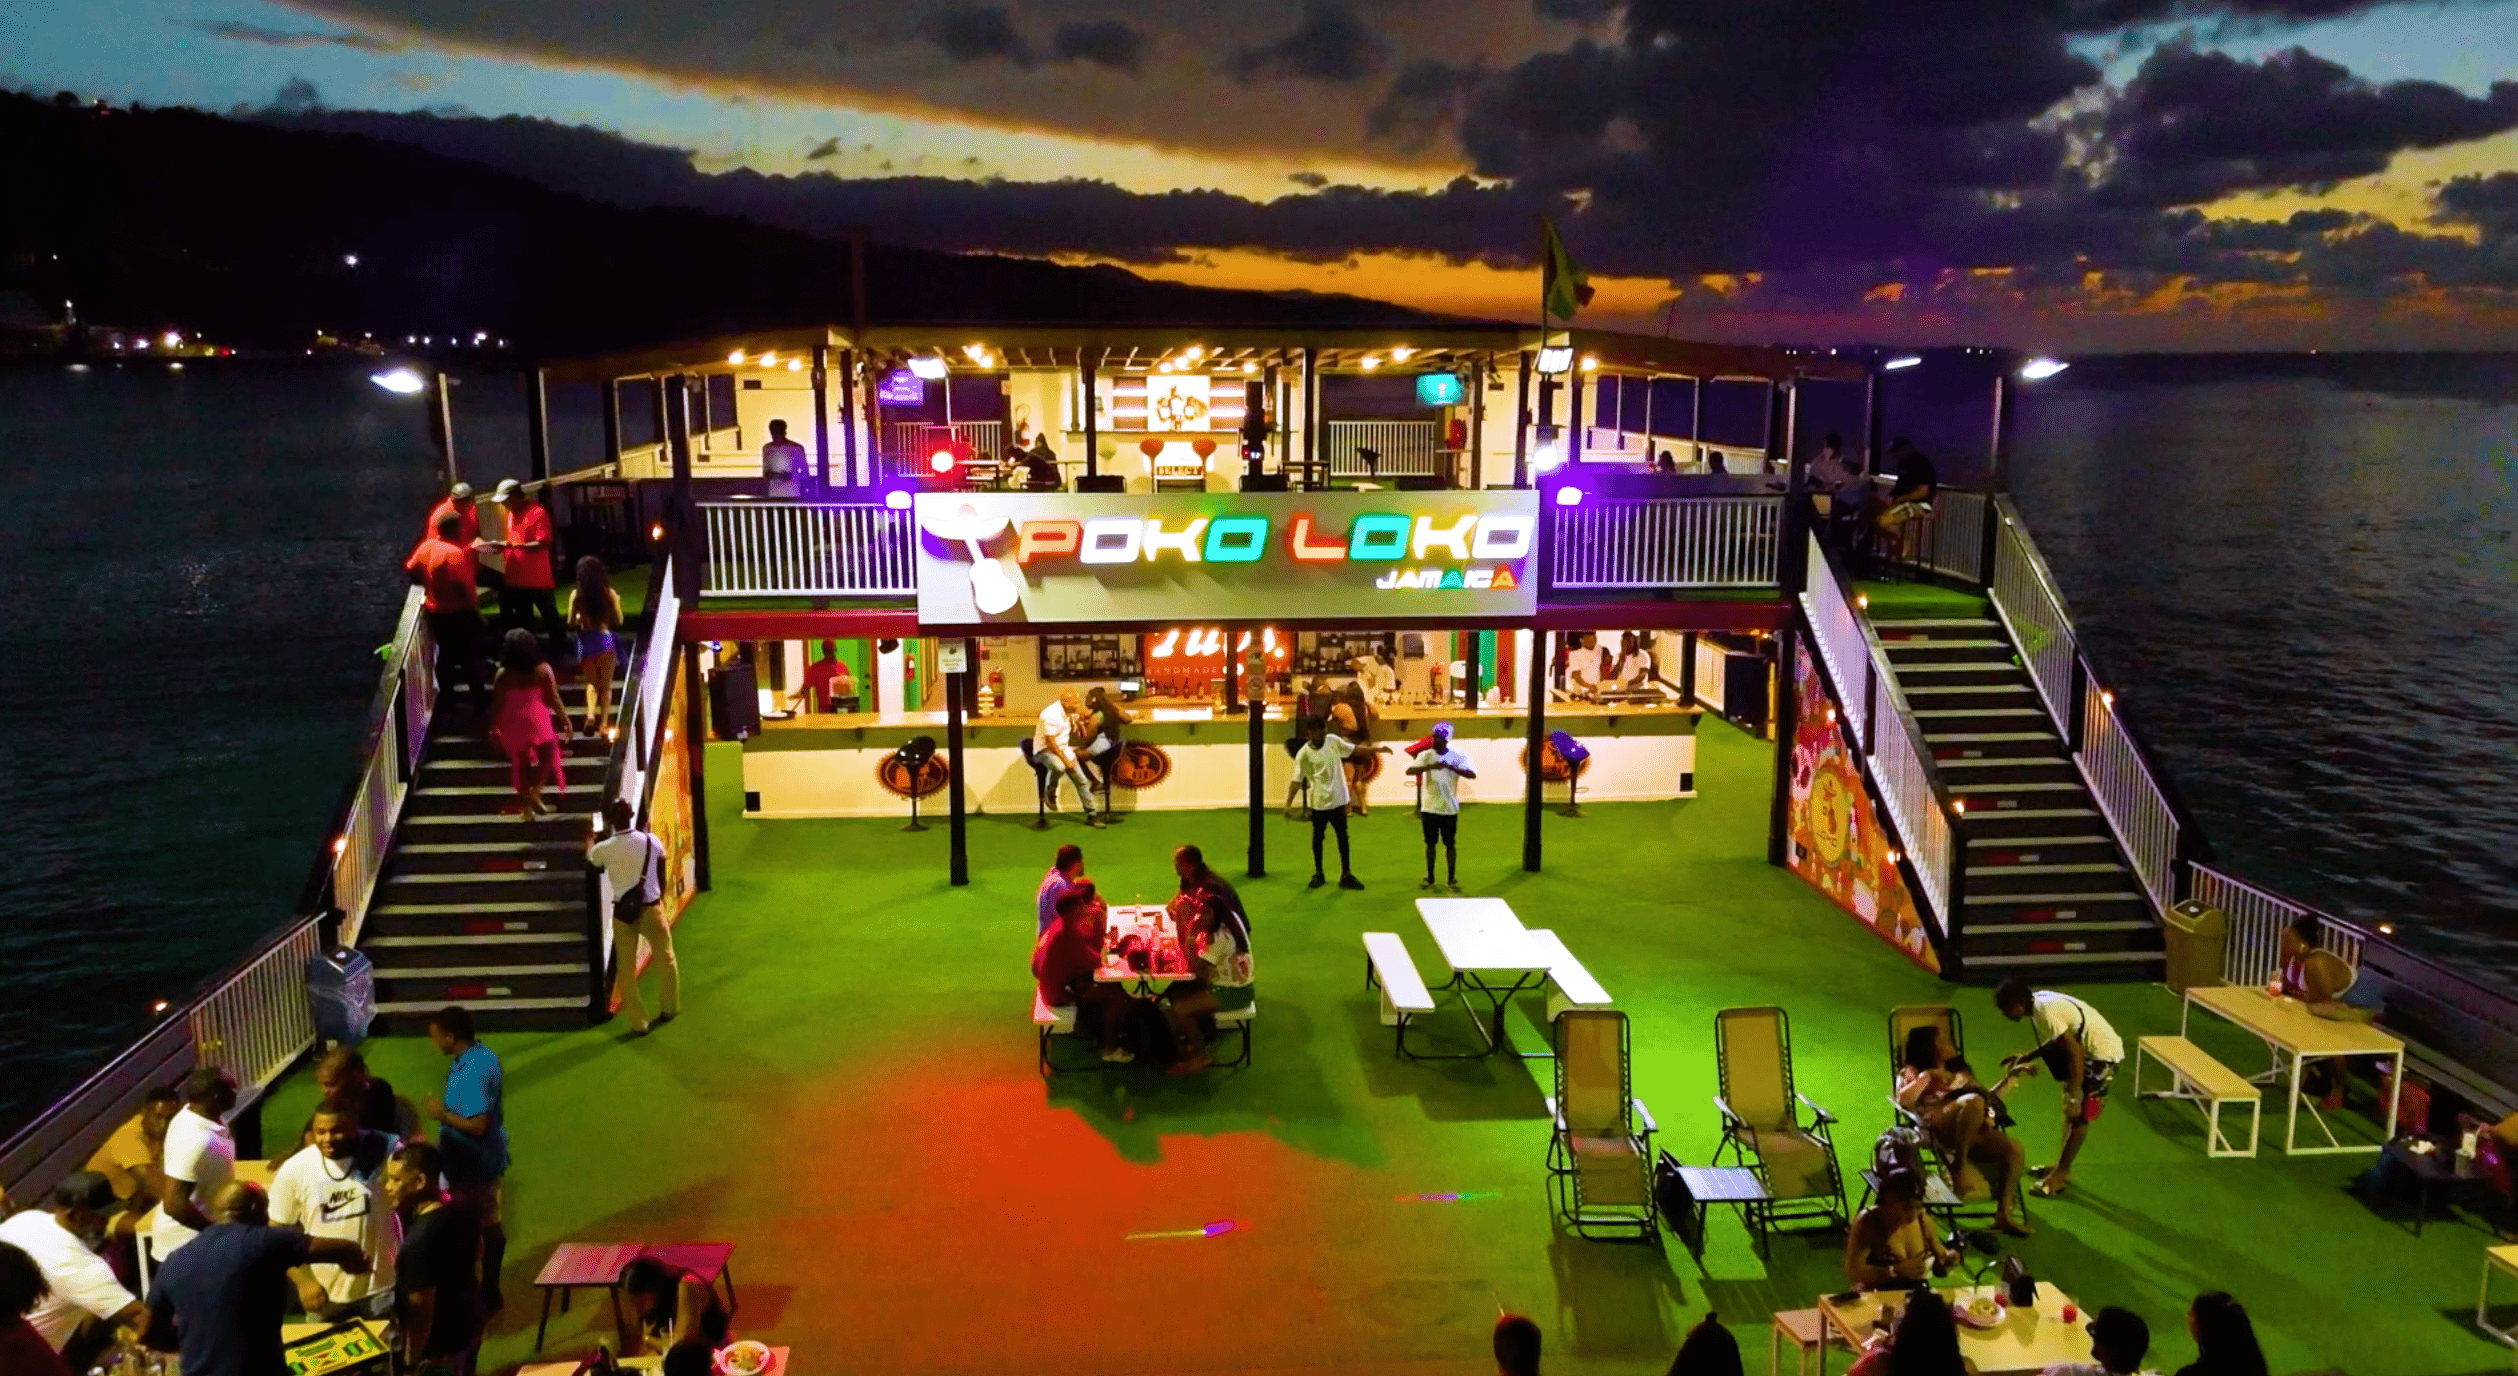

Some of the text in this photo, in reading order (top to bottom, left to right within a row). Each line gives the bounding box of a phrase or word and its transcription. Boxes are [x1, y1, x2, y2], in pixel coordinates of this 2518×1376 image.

[1017, 514, 1536, 564] POKO LOKO
[1375, 569, 1517, 590] JAMAICA
[329, 1187, 356, 1203] NIKE
